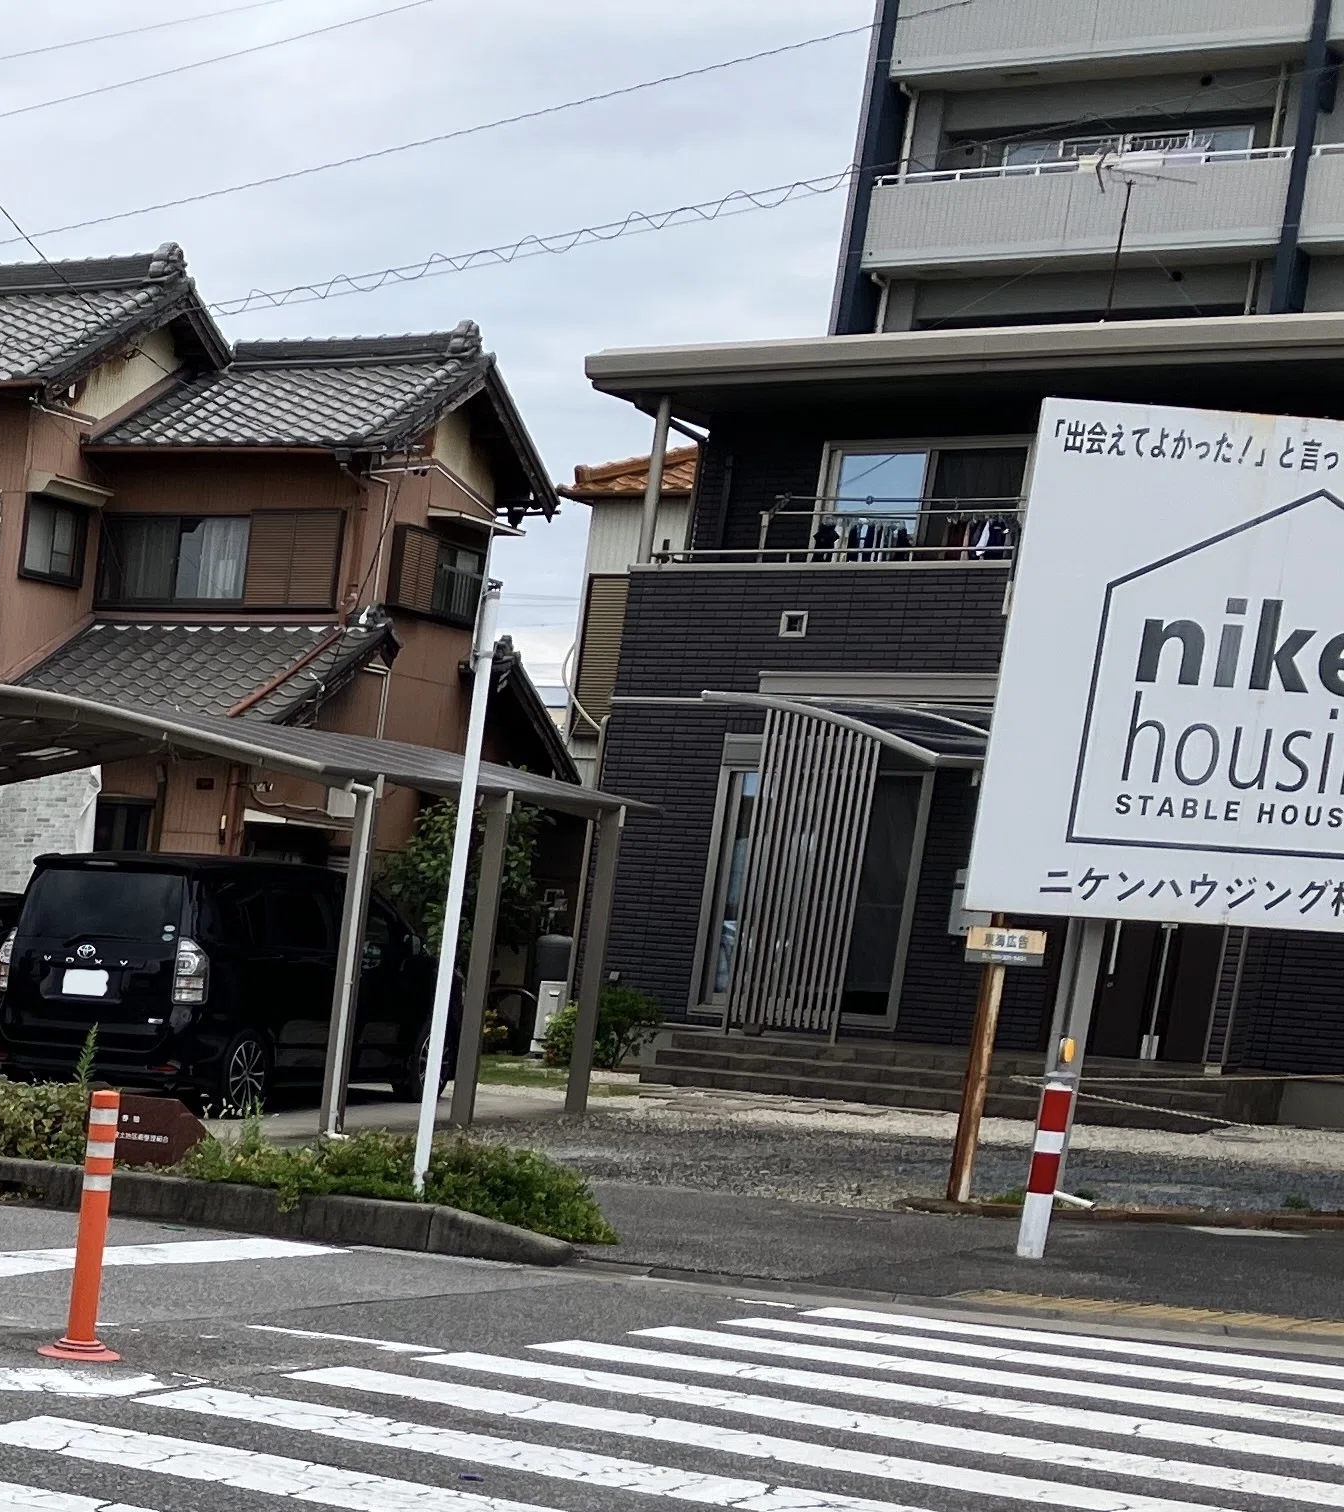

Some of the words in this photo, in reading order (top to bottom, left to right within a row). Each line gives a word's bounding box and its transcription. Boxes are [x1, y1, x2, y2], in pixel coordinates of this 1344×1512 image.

[1121, 690, 1344, 795] housi
[1115, 793, 1241, 822] STABLE
[1256, 802, 1344, 828] HOUS
[43, 954, 129, 967] VOXY
